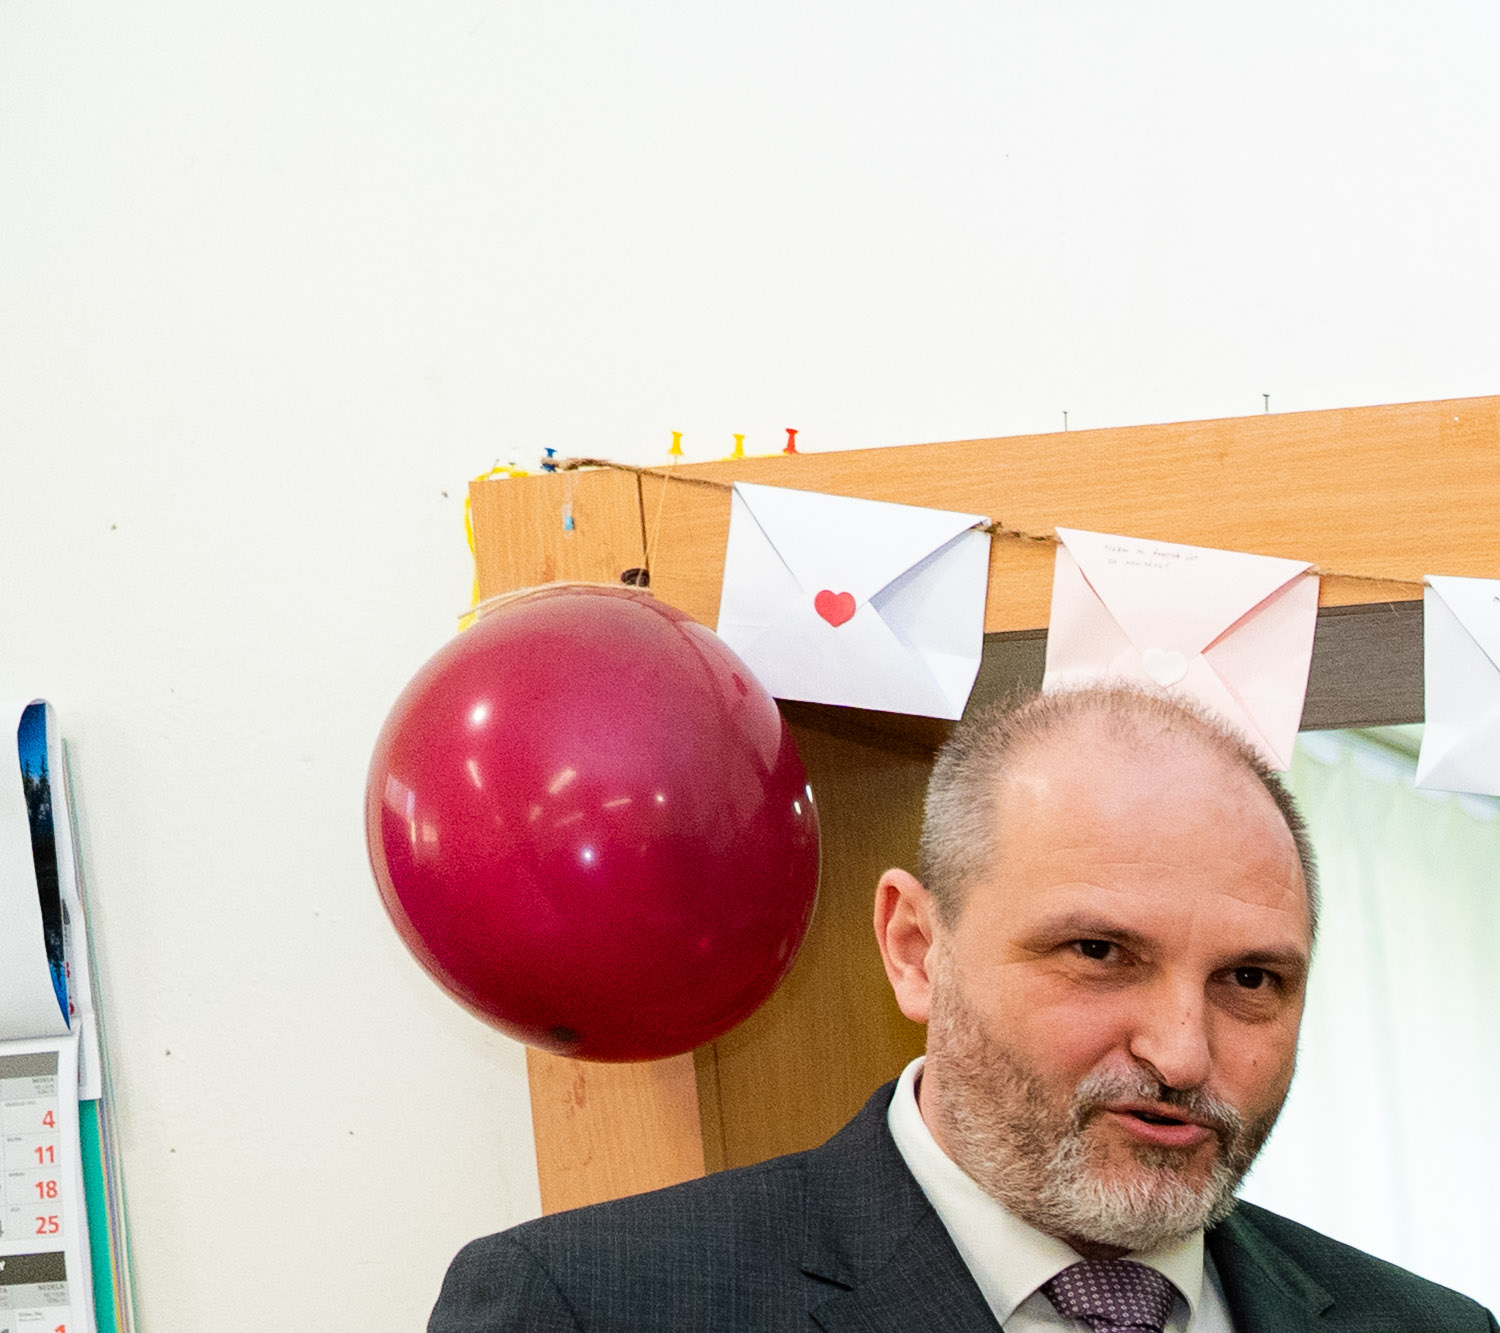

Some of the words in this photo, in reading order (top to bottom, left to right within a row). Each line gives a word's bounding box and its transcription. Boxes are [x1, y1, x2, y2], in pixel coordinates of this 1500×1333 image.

[42, 1110, 56, 1129] 4
[34, 1145, 55, 1164] 11
[35, 1179, 58, 1200] 18
[35, 1214, 60, 1236] 25
